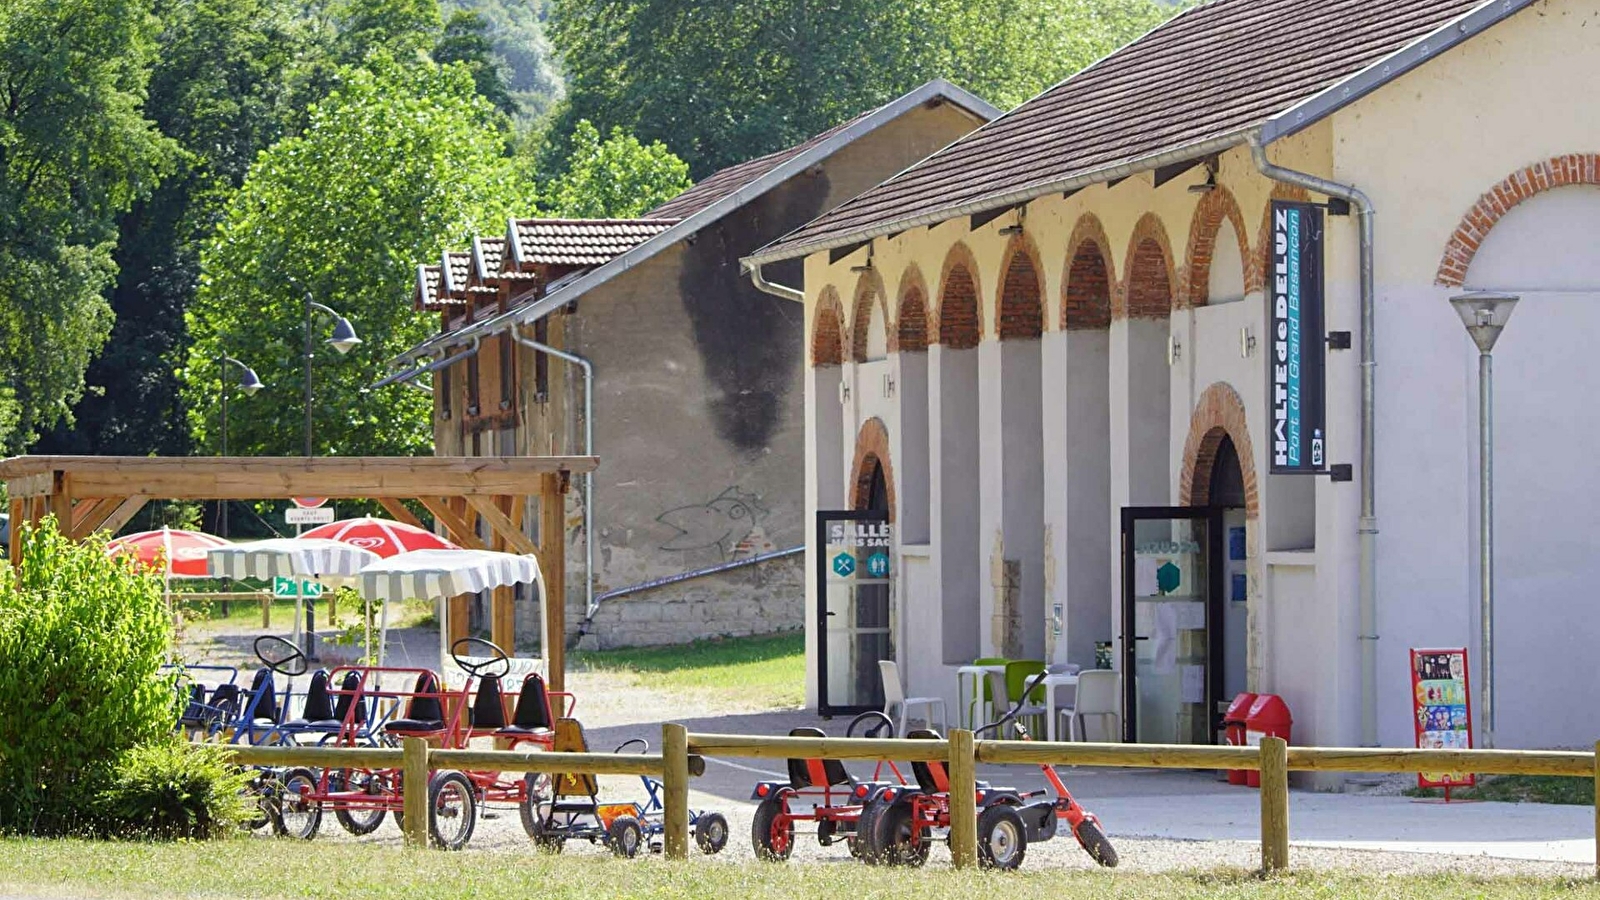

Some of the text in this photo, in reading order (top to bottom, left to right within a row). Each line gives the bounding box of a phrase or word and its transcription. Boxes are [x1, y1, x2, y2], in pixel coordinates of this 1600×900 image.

[1275, 209, 1288, 466] HALTE de DELUZ
[1289, 212, 1300, 462] Port du Grand Besançon
